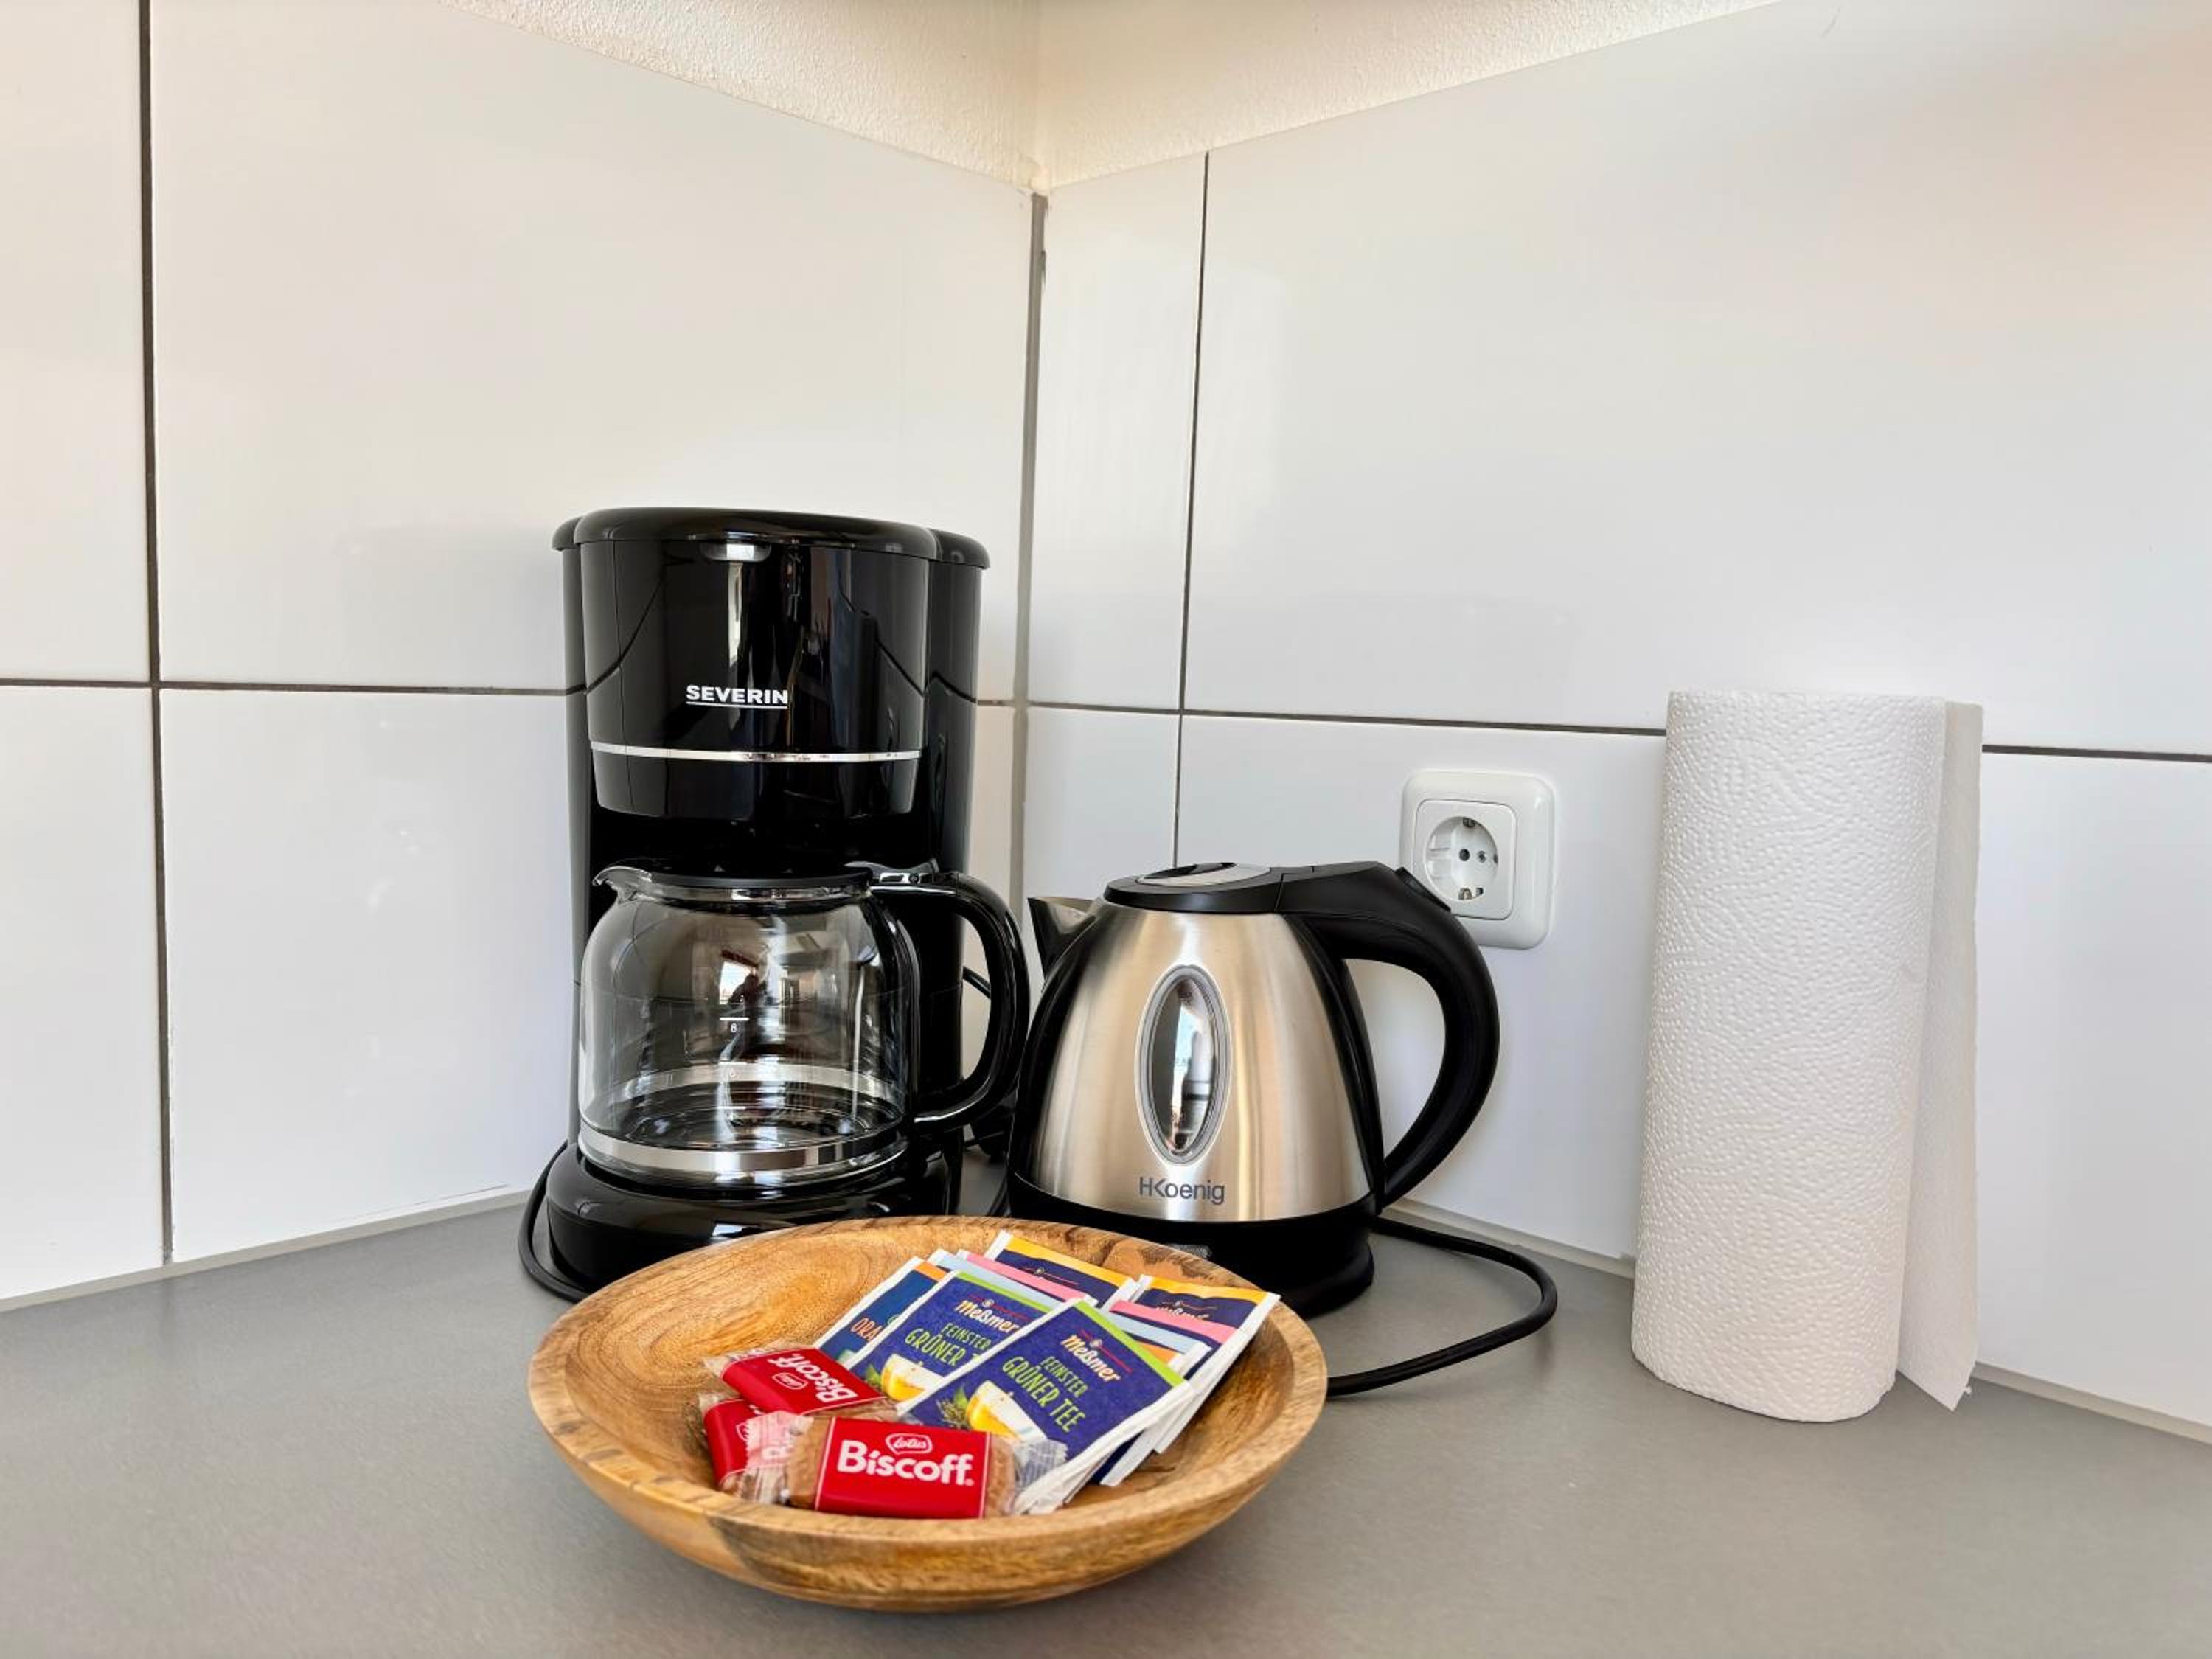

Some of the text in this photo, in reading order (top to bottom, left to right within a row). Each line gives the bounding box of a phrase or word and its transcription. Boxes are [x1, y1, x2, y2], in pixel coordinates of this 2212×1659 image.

[686, 684, 788, 705] SEVERIN
[731, 1023, 737, 1032] 8
[954, 1300, 1020, 1333] Meßmer
[905, 1328, 966, 1366] GRÜNER
[940, 1322, 992, 1350] FEINSTER
[1061, 1335, 1121, 1382] Meßmer
[1040, 1356, 1088, 1397] FEINSTER
[1002, 1356, 1086, 1433] GRÜNER TEE
